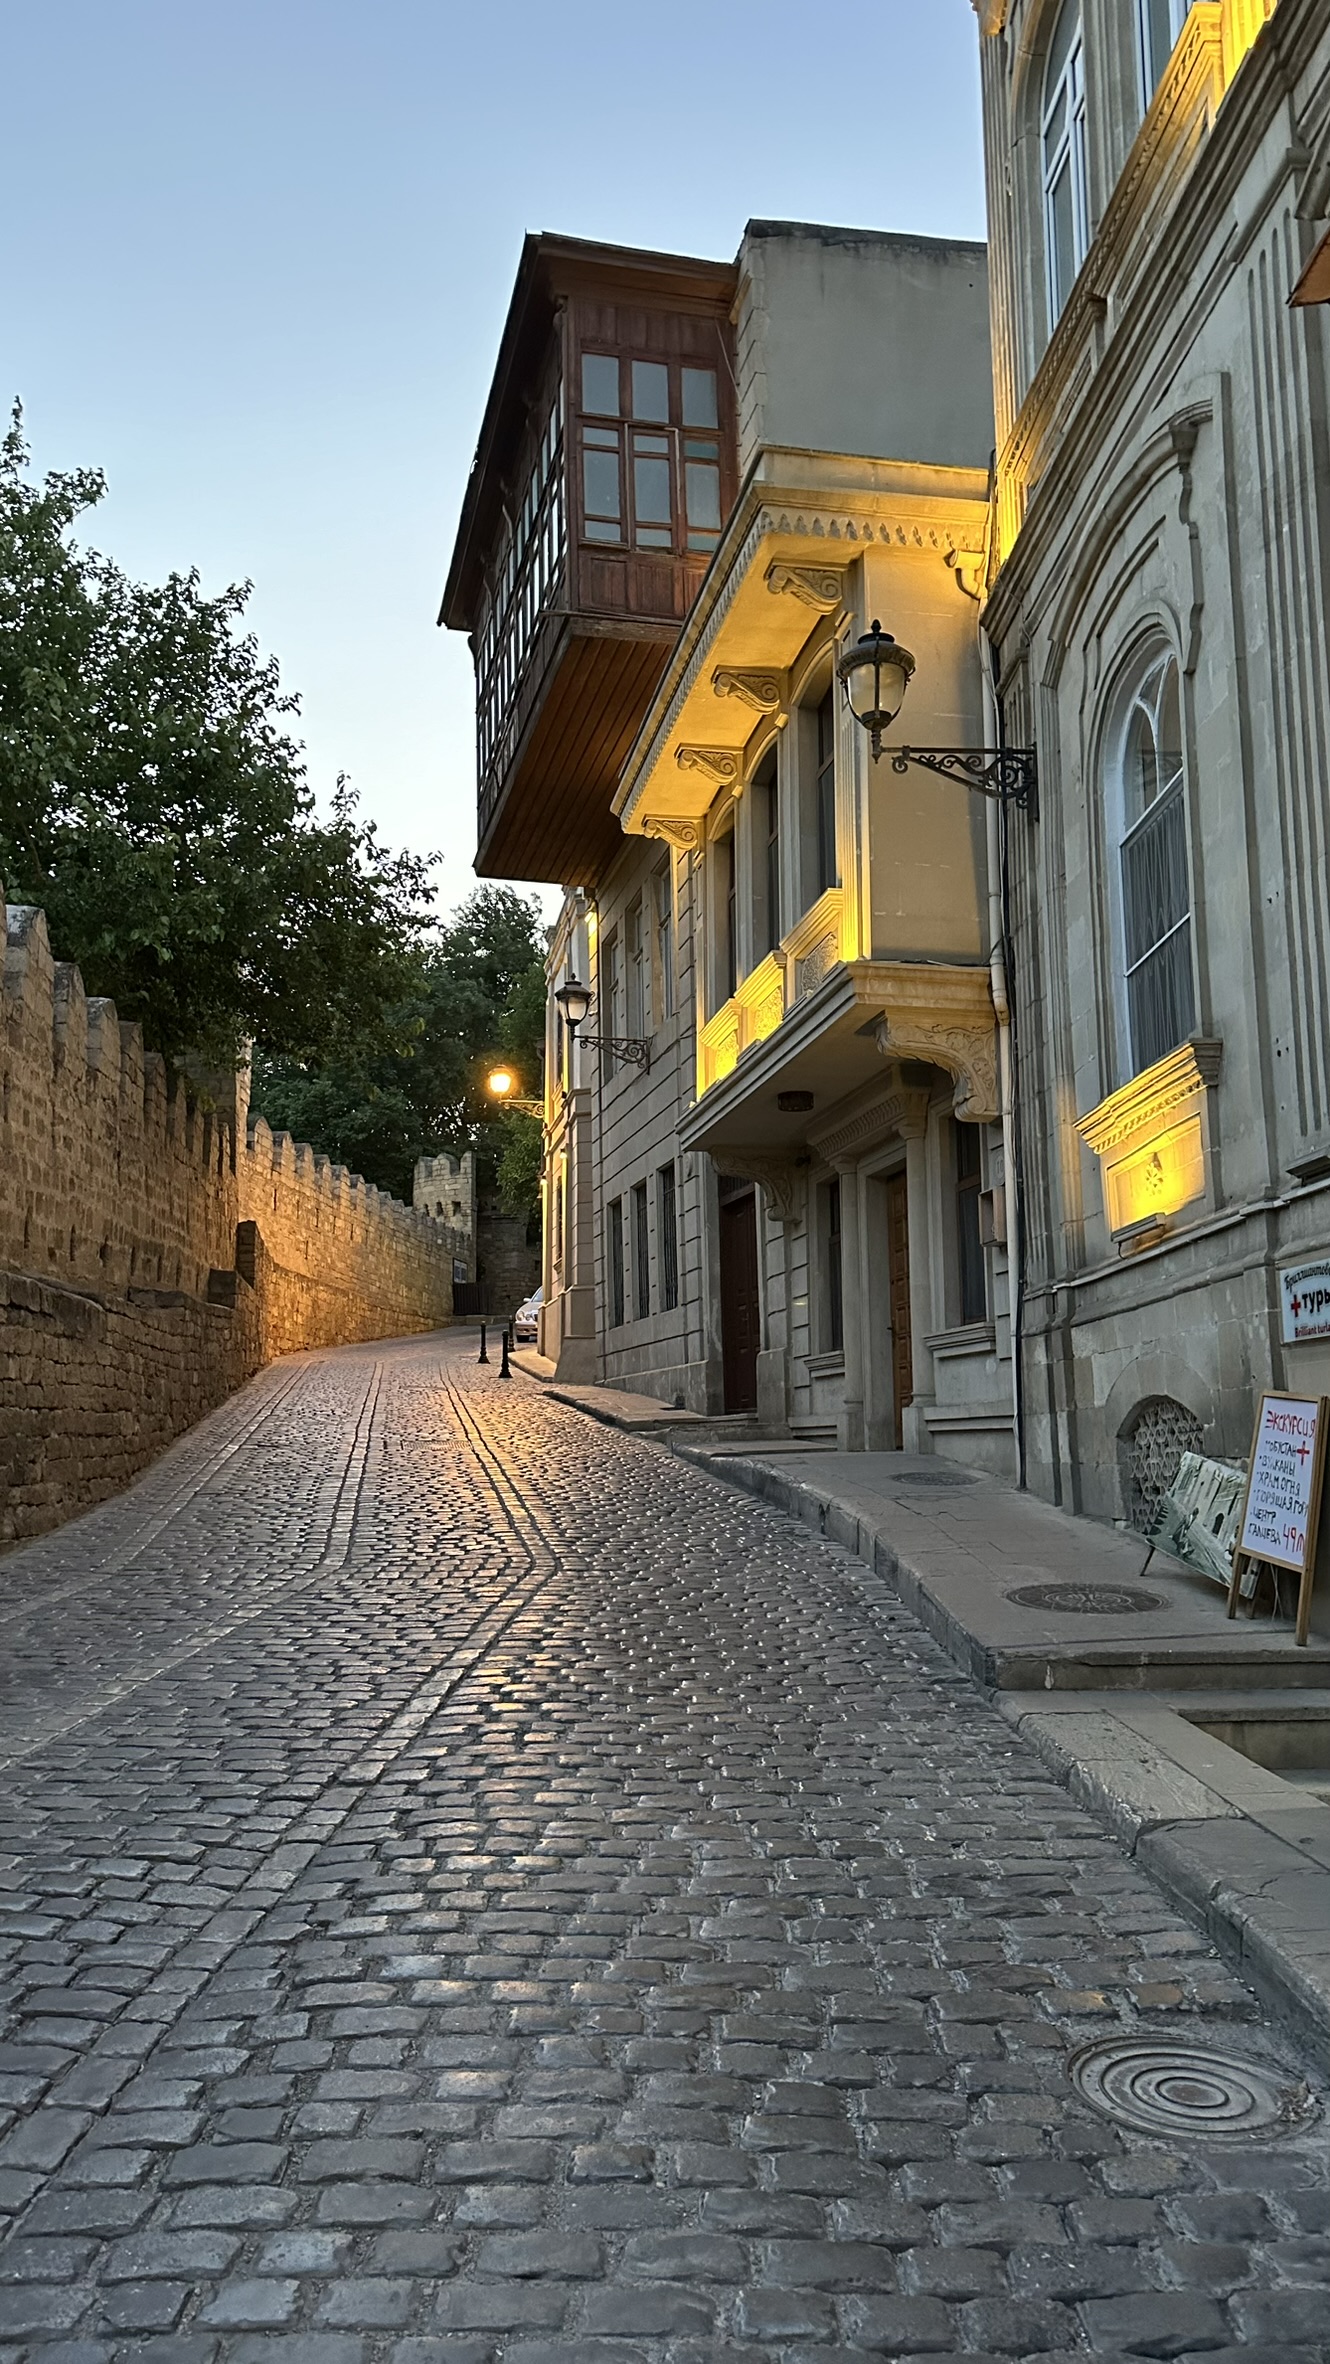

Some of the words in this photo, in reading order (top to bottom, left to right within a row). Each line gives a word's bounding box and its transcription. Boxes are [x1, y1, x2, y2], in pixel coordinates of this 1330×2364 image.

[1284, 1262, 1330, 1293] Бриллиантов
[1295, 1325, 1317, 1338] Brilliant
[1258, 1471, 1280, 1489] ХРАМ
[1280, 1477, 1301, 1497] ОГНЯ
[1253, 1506, 1277, 1524] ЦЕНТР
